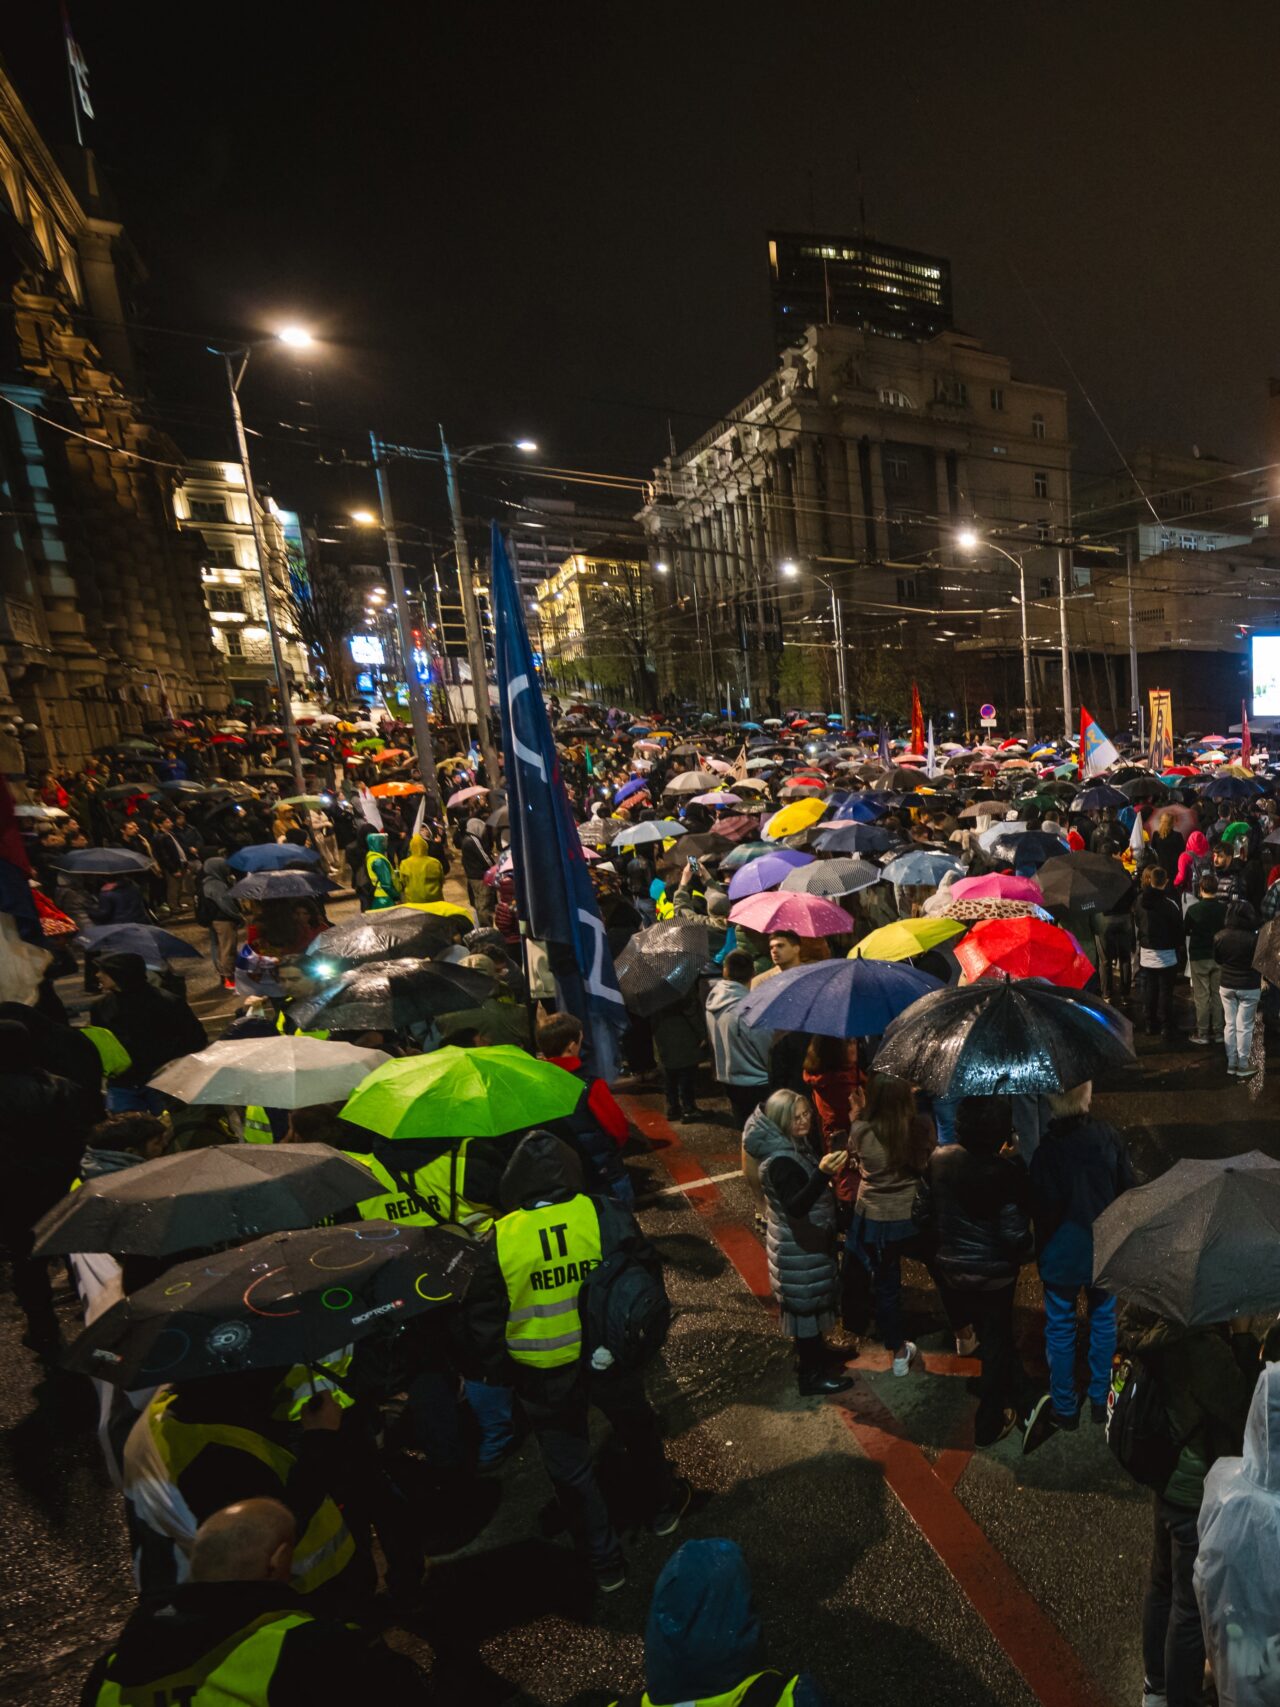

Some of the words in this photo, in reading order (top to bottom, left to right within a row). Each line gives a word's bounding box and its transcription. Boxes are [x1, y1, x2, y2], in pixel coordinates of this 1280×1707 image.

[385, 1195, 441, 1220] REDR
[538, 1223, 568, 1262] IT
[529, 1260, 592, 1291] REDAR
